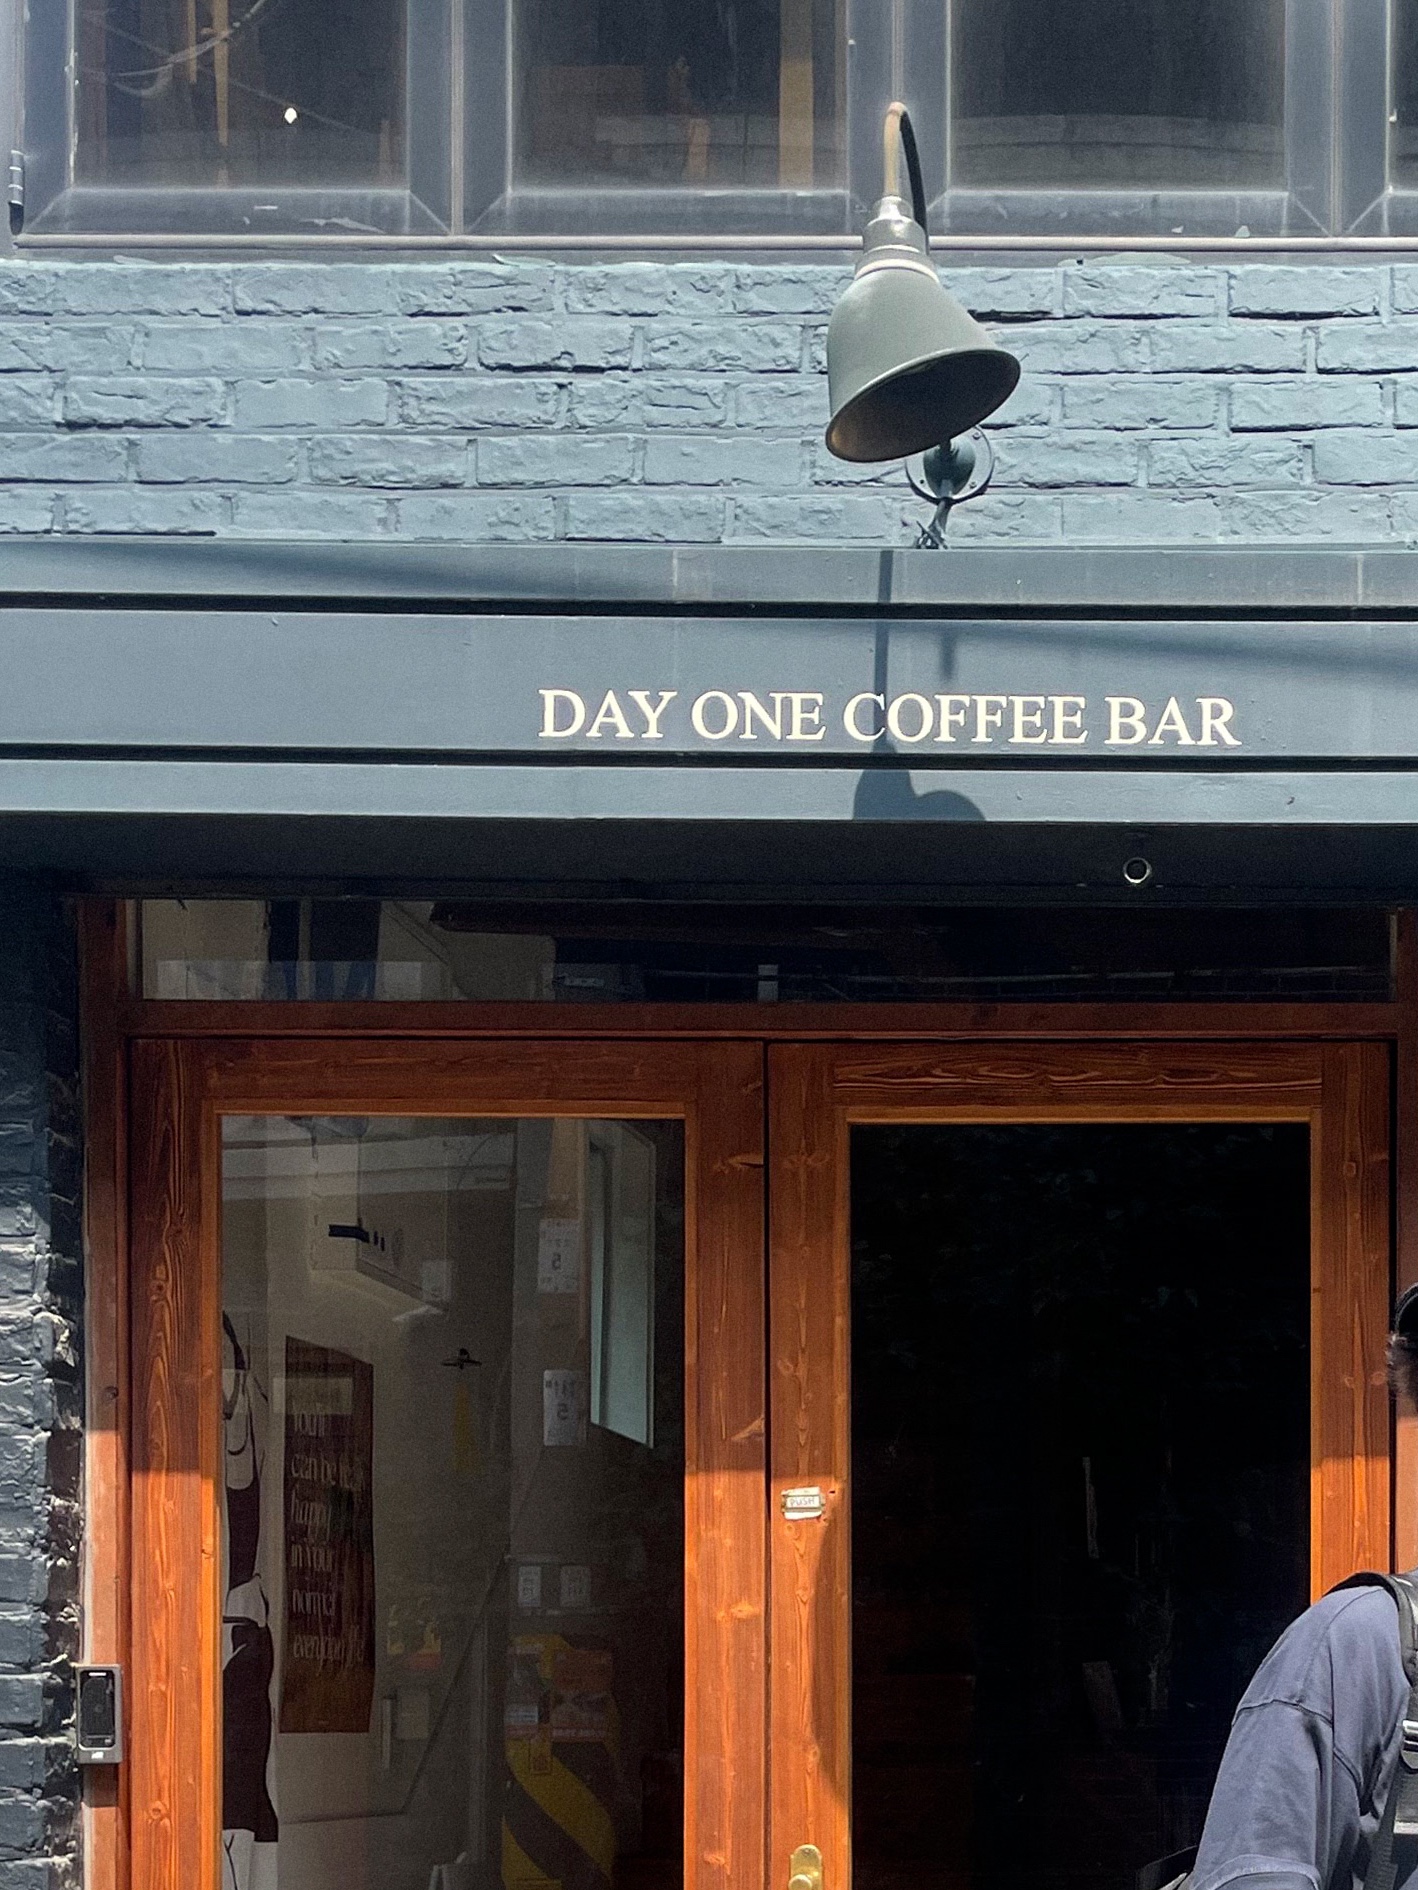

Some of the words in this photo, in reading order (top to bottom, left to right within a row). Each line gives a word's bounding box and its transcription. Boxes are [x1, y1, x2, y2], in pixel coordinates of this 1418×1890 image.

[538, 688, 677, 739] DAY
[690, 690, 826, 742] ONE
[844, 692, 1088, 745] COFFEE
[1104, 697, 1242, 747] BAR
[790, 1498, 815, 1506] PUSH
